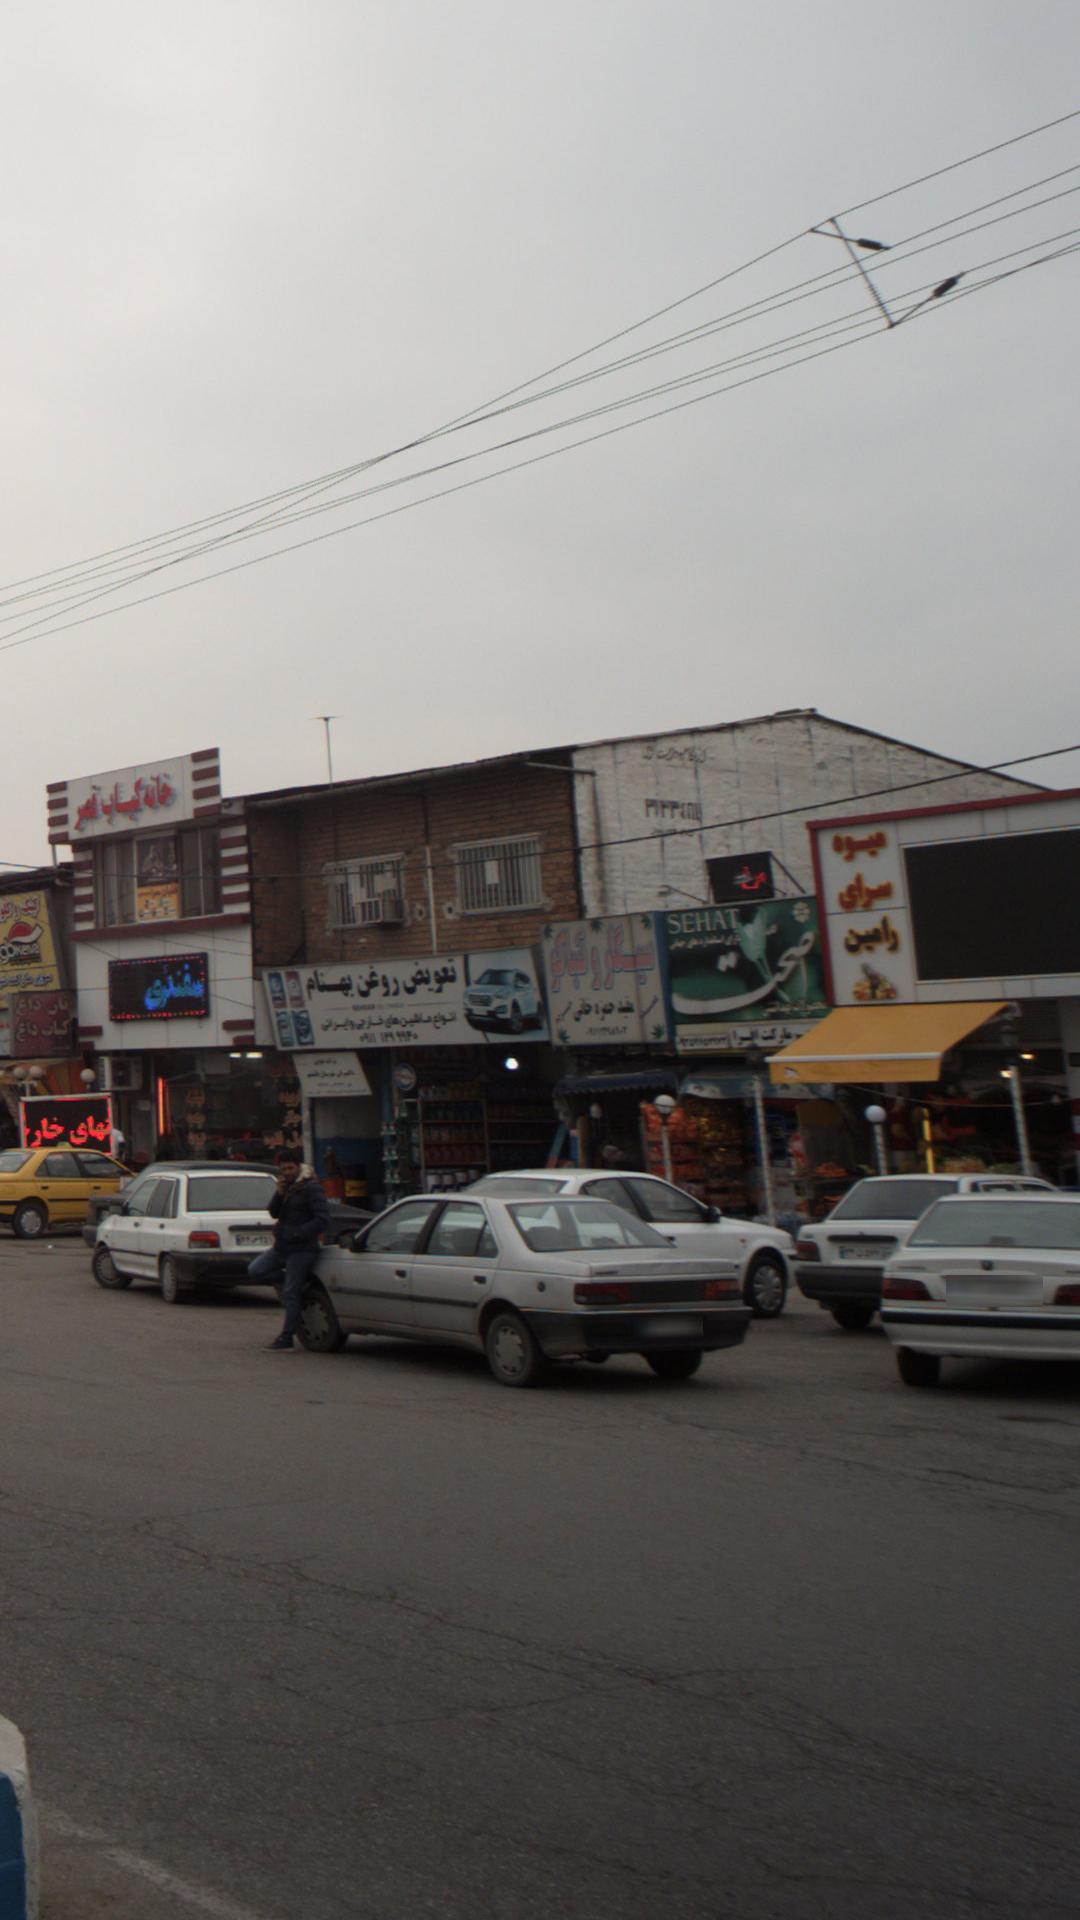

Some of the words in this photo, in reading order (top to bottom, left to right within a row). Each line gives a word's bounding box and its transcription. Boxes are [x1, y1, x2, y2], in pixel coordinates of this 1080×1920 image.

[832, 831, 886, 862] میوه
[838, 872, 893, 911] سرای
[668, 908, 740, 935] SEHAT
[844, 915, 899, 956] رامین
[306, 968, 354, 1000] بهنام
[357, 965, 401, 999] روغن
[403, 958, 458, 995] تعویض
